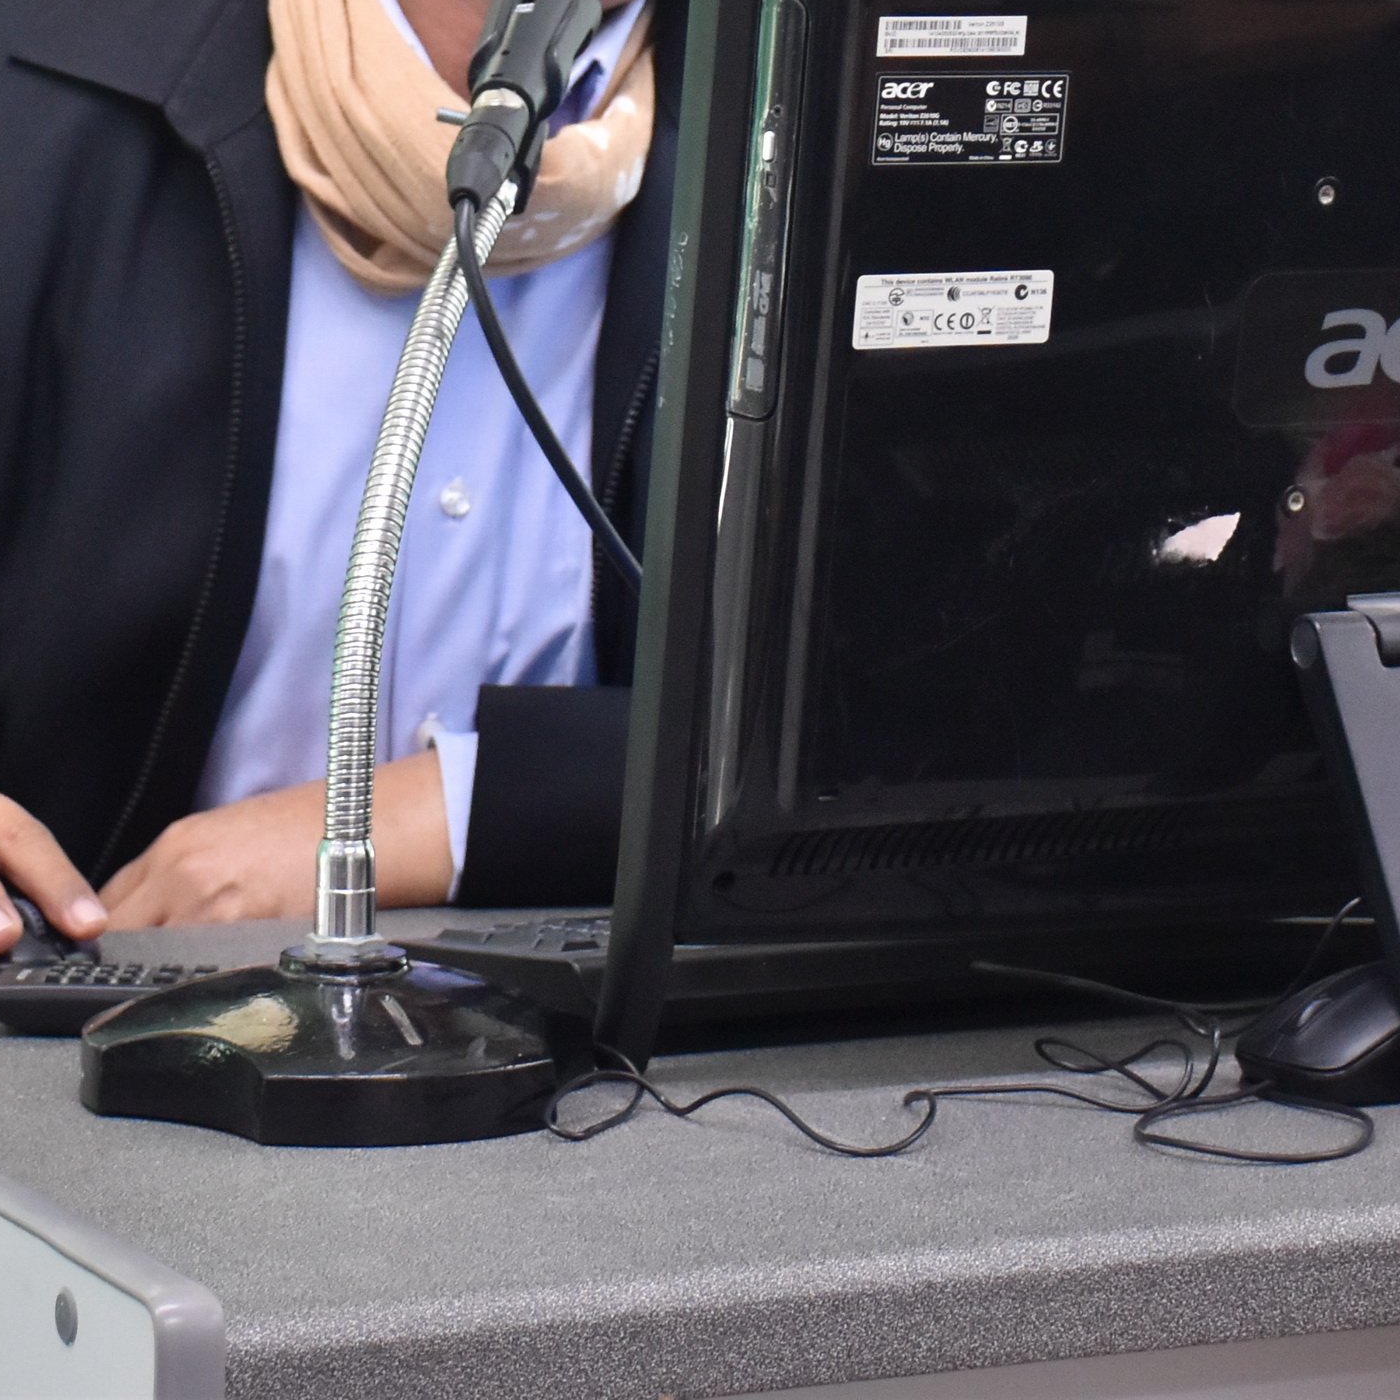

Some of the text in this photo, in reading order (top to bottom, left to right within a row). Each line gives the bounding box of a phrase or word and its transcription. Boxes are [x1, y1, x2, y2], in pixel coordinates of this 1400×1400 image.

[881, 81, 935, 99] acer
[894, 131, 999, 144] Lamp(s) Contain Mercury.
[893, 142, 965, 154] Dispose Properly.
